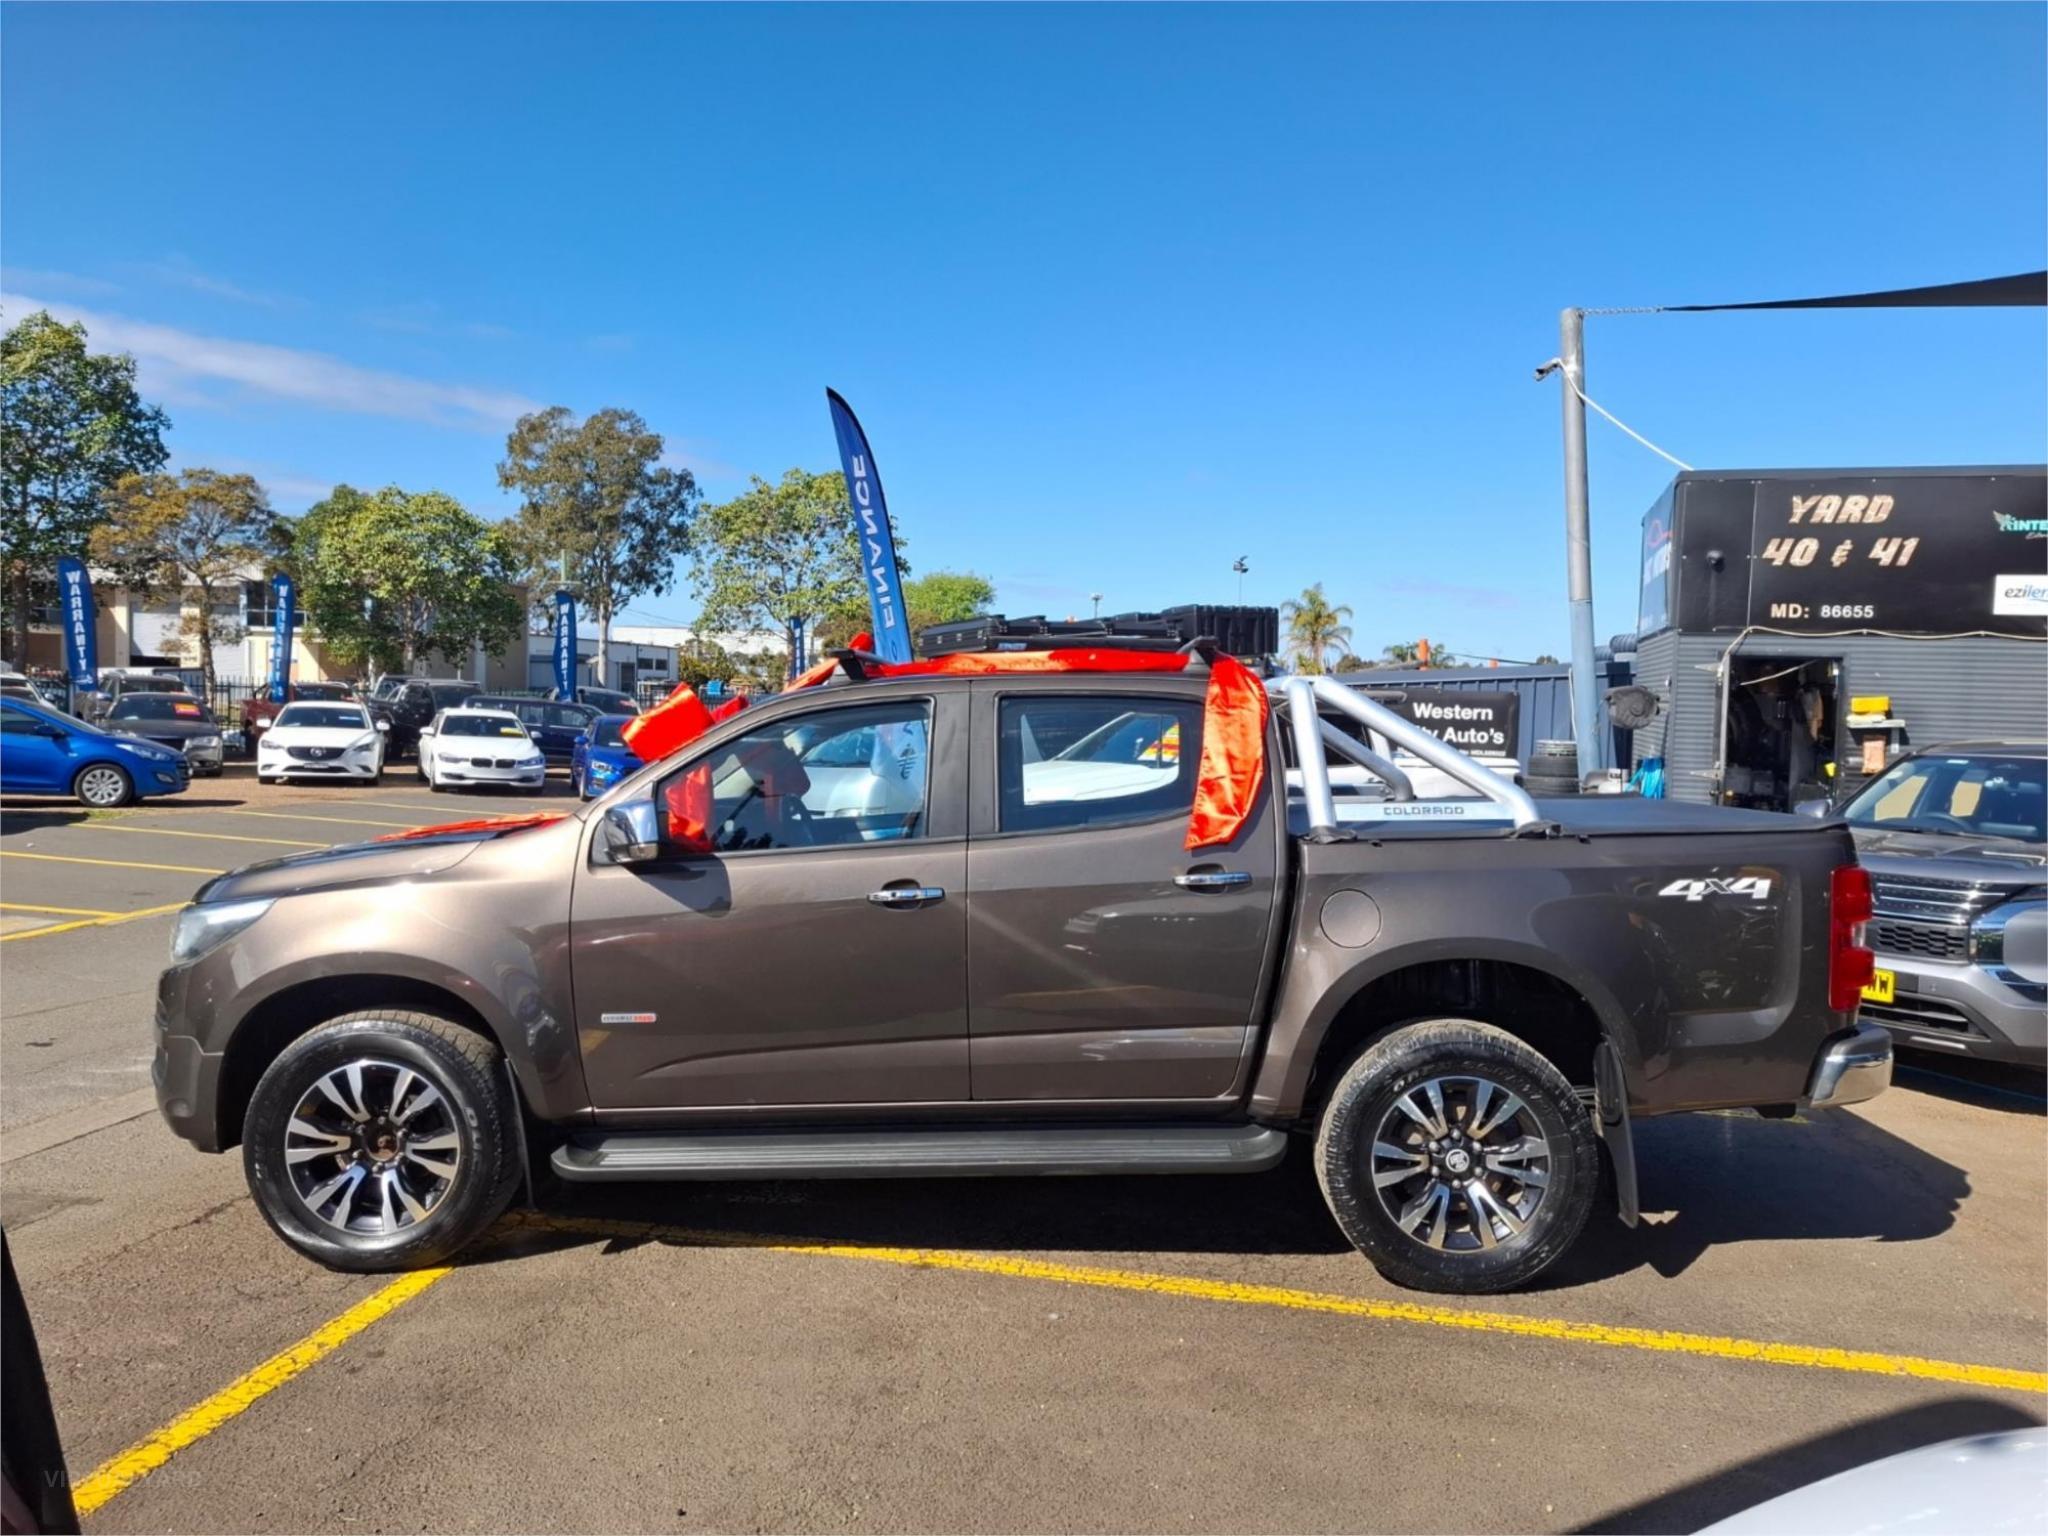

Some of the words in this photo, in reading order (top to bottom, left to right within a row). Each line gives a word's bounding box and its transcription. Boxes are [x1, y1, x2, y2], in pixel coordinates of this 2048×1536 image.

[1788, 495, 1894, 523] YARD
[1762, 537, 1819, 566] 40
[1868, 537, 1920, 566] 41
[1771, 603, 1809, 618] MD:
[1820, 605, 1874, 618] 86655
[1413, 702, 1493, 720] Western
[1443, 727, 1504, 744] Auto's
[1384, 806, 1465, 816] COLORADO
